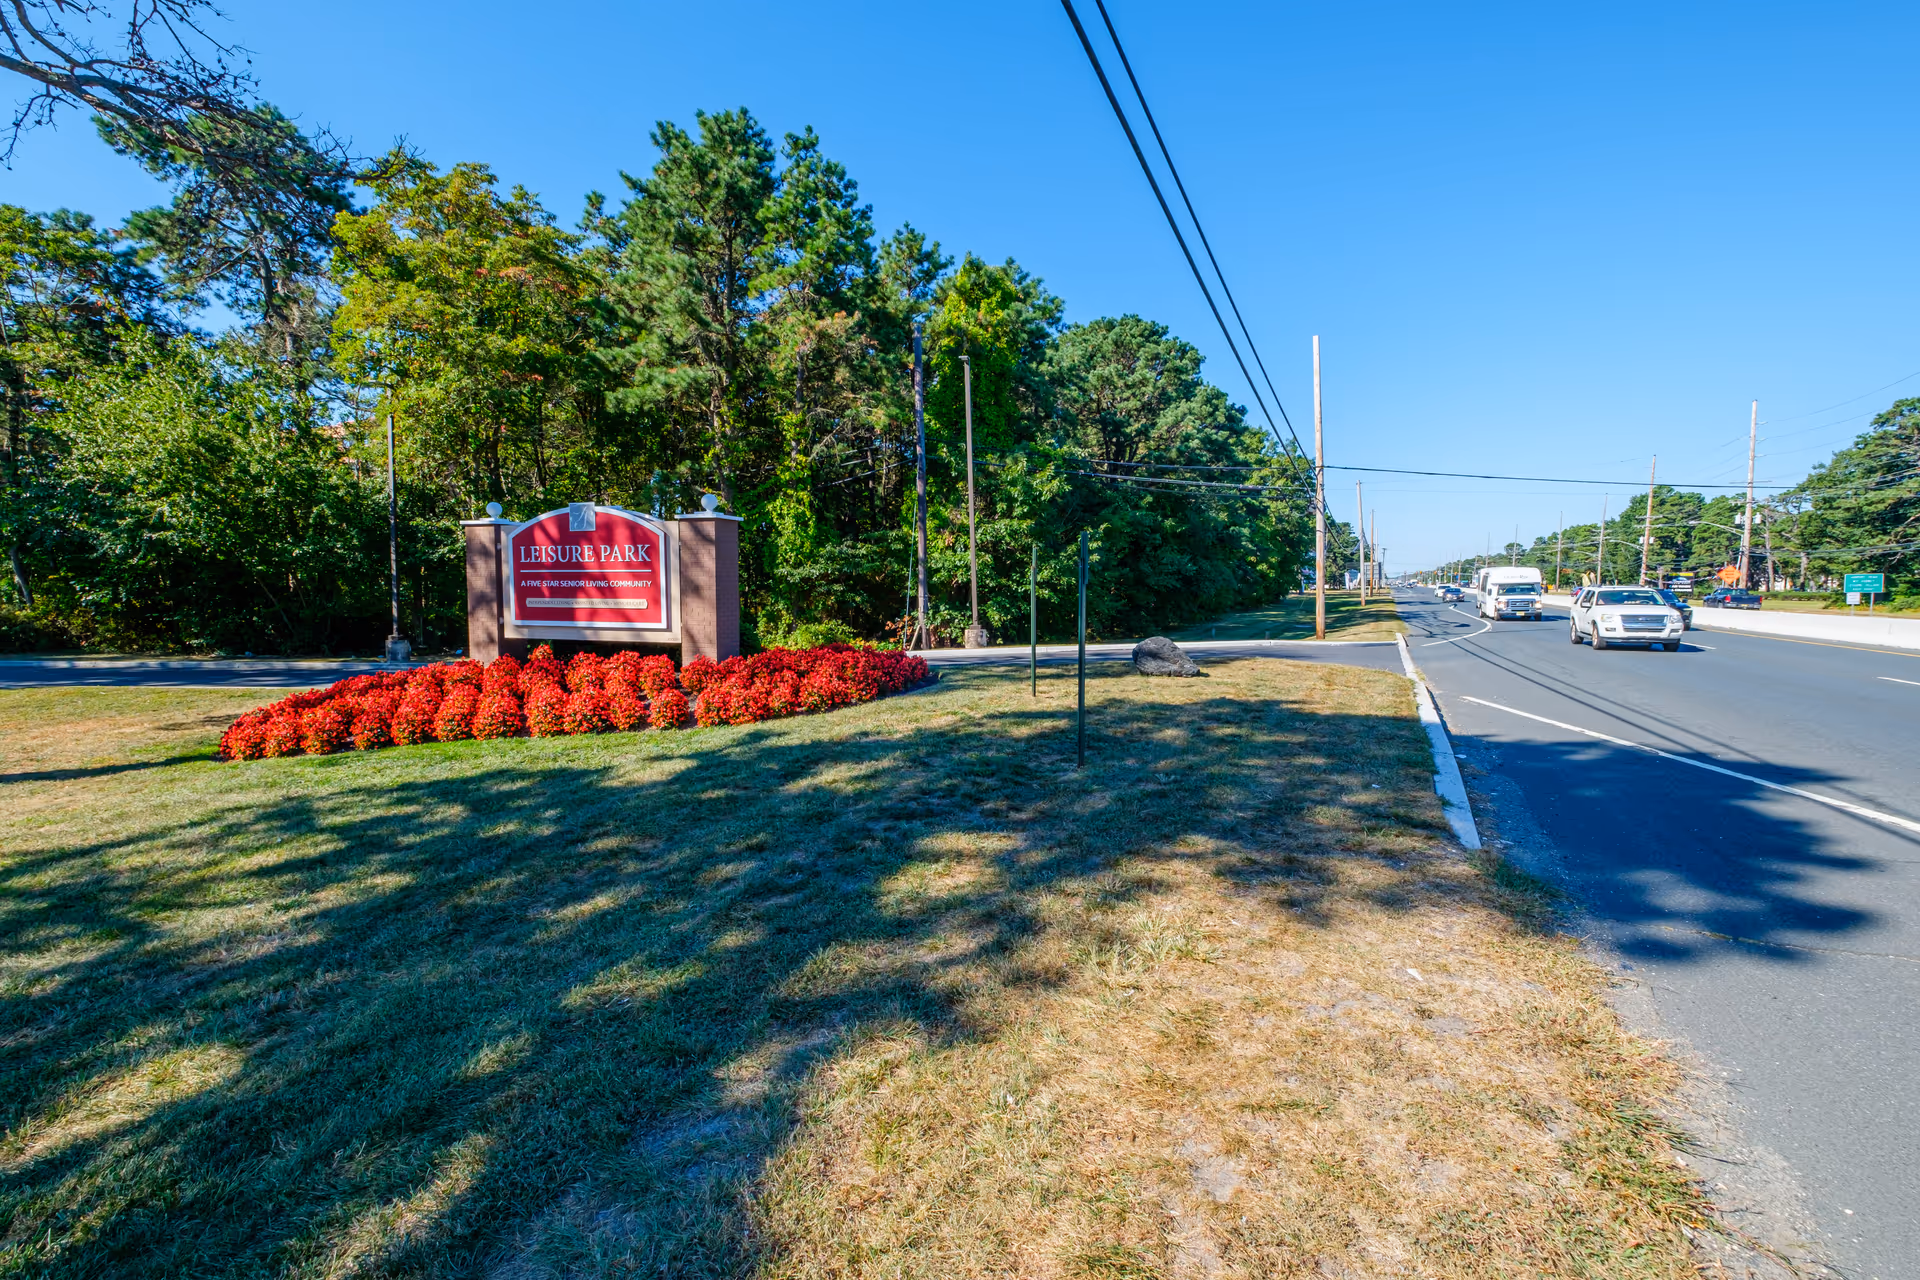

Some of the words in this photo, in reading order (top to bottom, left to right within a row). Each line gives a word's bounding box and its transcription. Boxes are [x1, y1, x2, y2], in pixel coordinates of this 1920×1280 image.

[520, 545, 595, 562] LEISURE
[600, 544, 651, 562] PARK
[586, 580, 608, 588] LIVING
[610, 580, 652, 588] COMMUNITY
